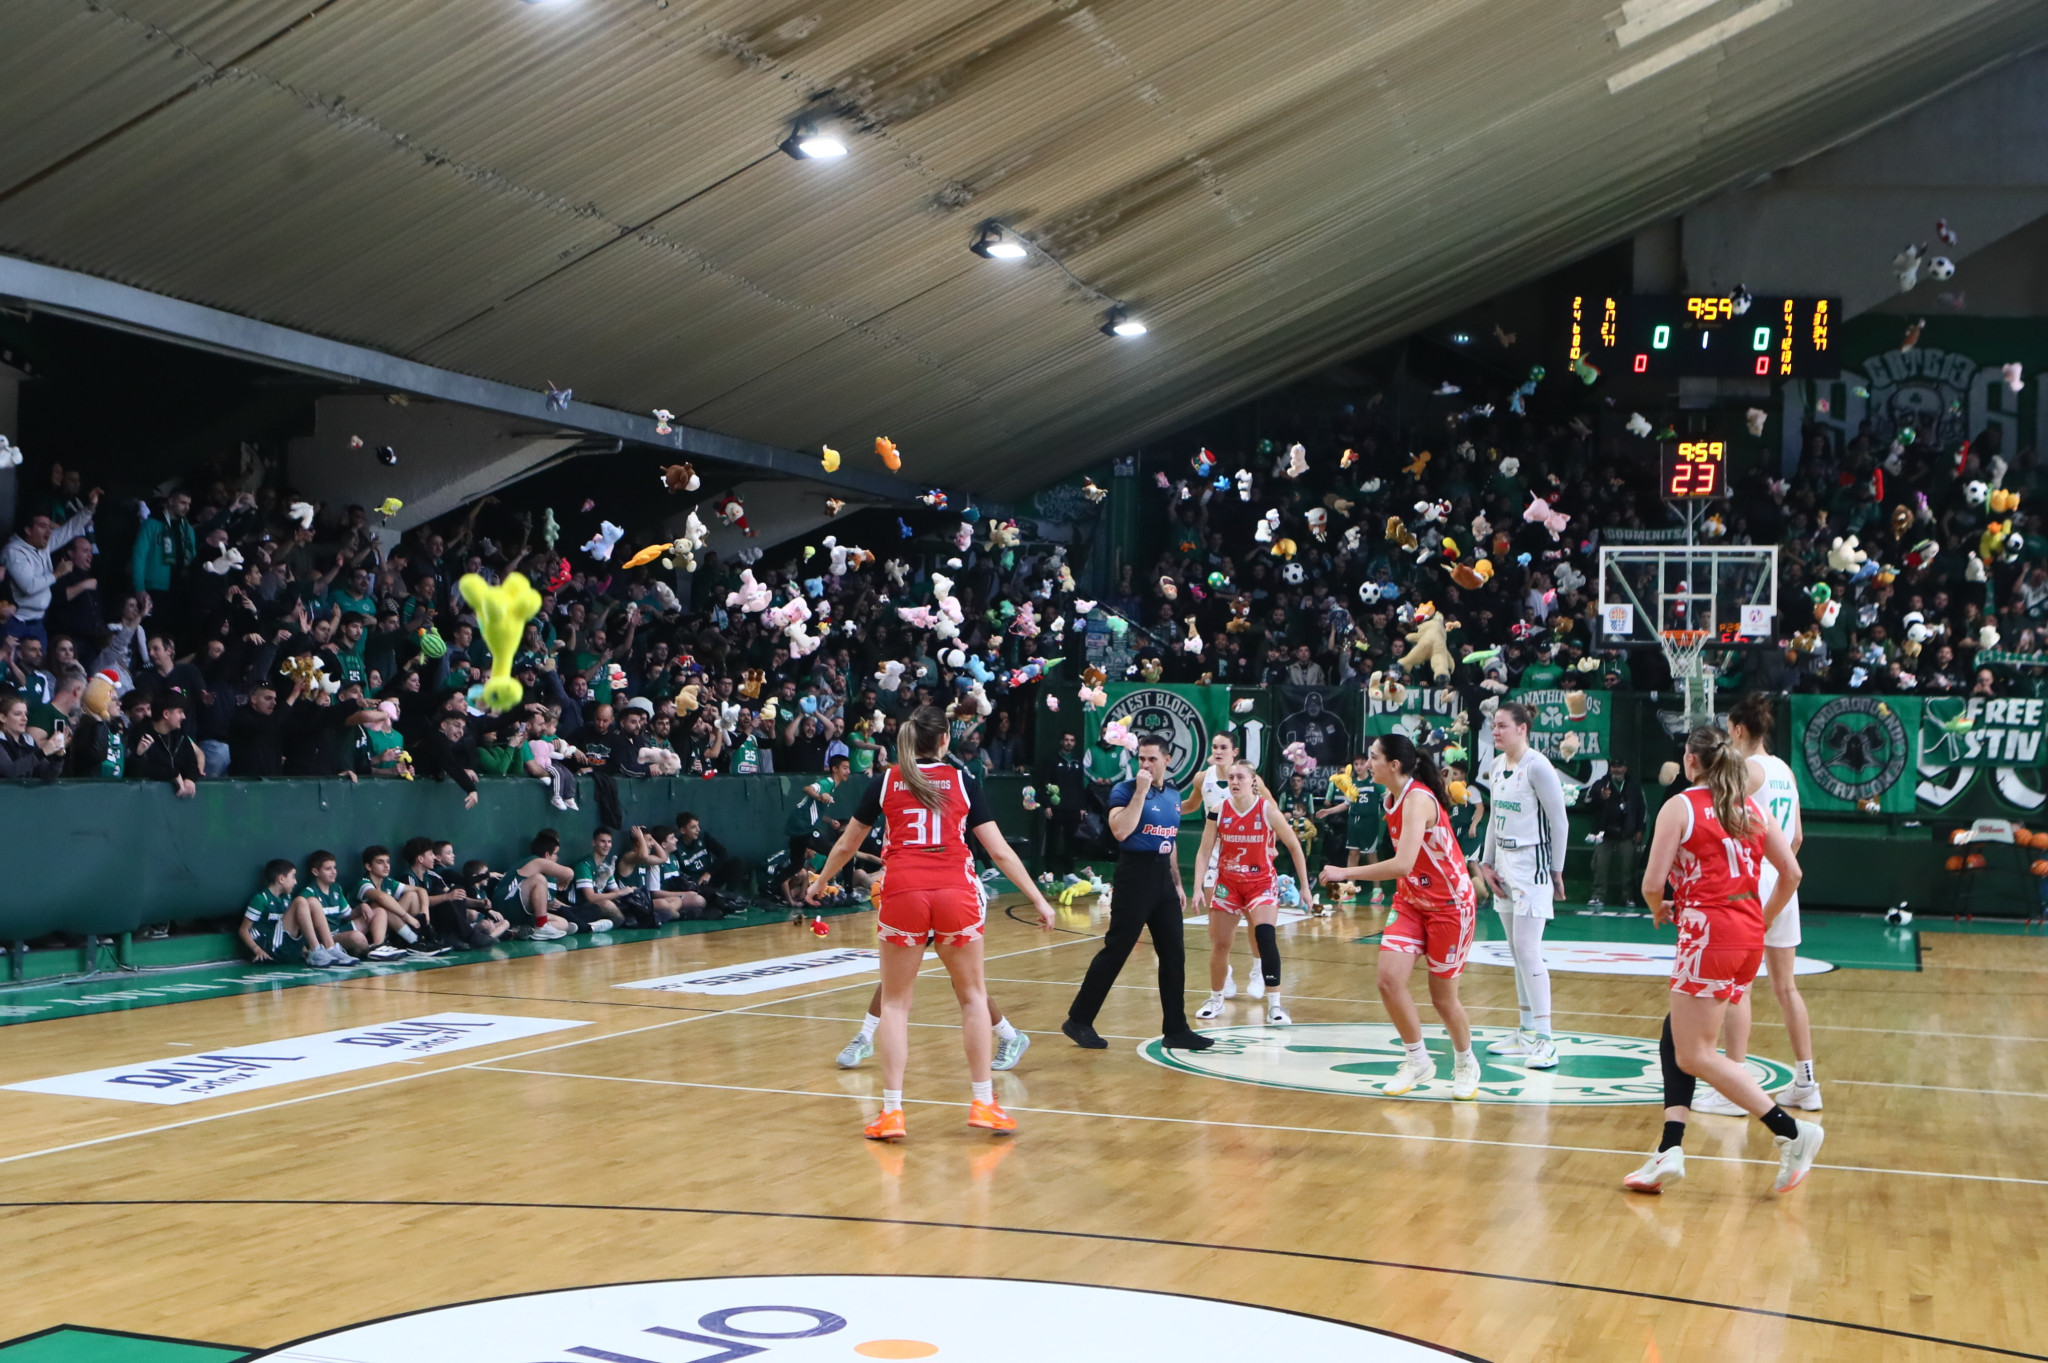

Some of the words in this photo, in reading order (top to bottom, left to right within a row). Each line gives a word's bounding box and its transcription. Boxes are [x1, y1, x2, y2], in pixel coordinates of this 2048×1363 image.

[1573, 296, 1581, 309] 2
[1687, 297, 1732, 320] 9:59
[1784, 300, 1793, 312] 0
[1573, 310, 1581, 321] 4
[1605, 310, 1615, 322] 17
[1784, 313, 1793, 324] 4
[1573, 322, 1580, 334] 6
[1601, 322, 1615, 334] 21
[1785, 324, 1793, 337] 7
[1572, 334, 1580, 347] 8
[1602, 335, 1615, 347] 77
[1653, 325, 1670, 349] 0
[1702, 330, 1709, 349] 1
[1753, 326, 1770, 350] 0
[1813, 338, 1827, 351] 77
[1634, 354, 1648, 372] 0
[1755, 356, 1769, 375] 0
[1678, 442, 1723, 462] 9:59
[1671, 464, 1715, 493] 23
[1112, 692, 1151, 722] WEST
[1156, 692, 1197, 727] BLOCK
[1966, 697, 2044, 726] FREE
[1963, 728, 2043, 762] STIV
[745, 750, 756, 761] 25
[1769, 780, 1791, 791] VITOLA
[1769, 797, 1792, 831] 17
[903, 808, 942, 846] 31
[1496, 815, 1506, 831] 77
[1237, 848, 1248, 862] 7
